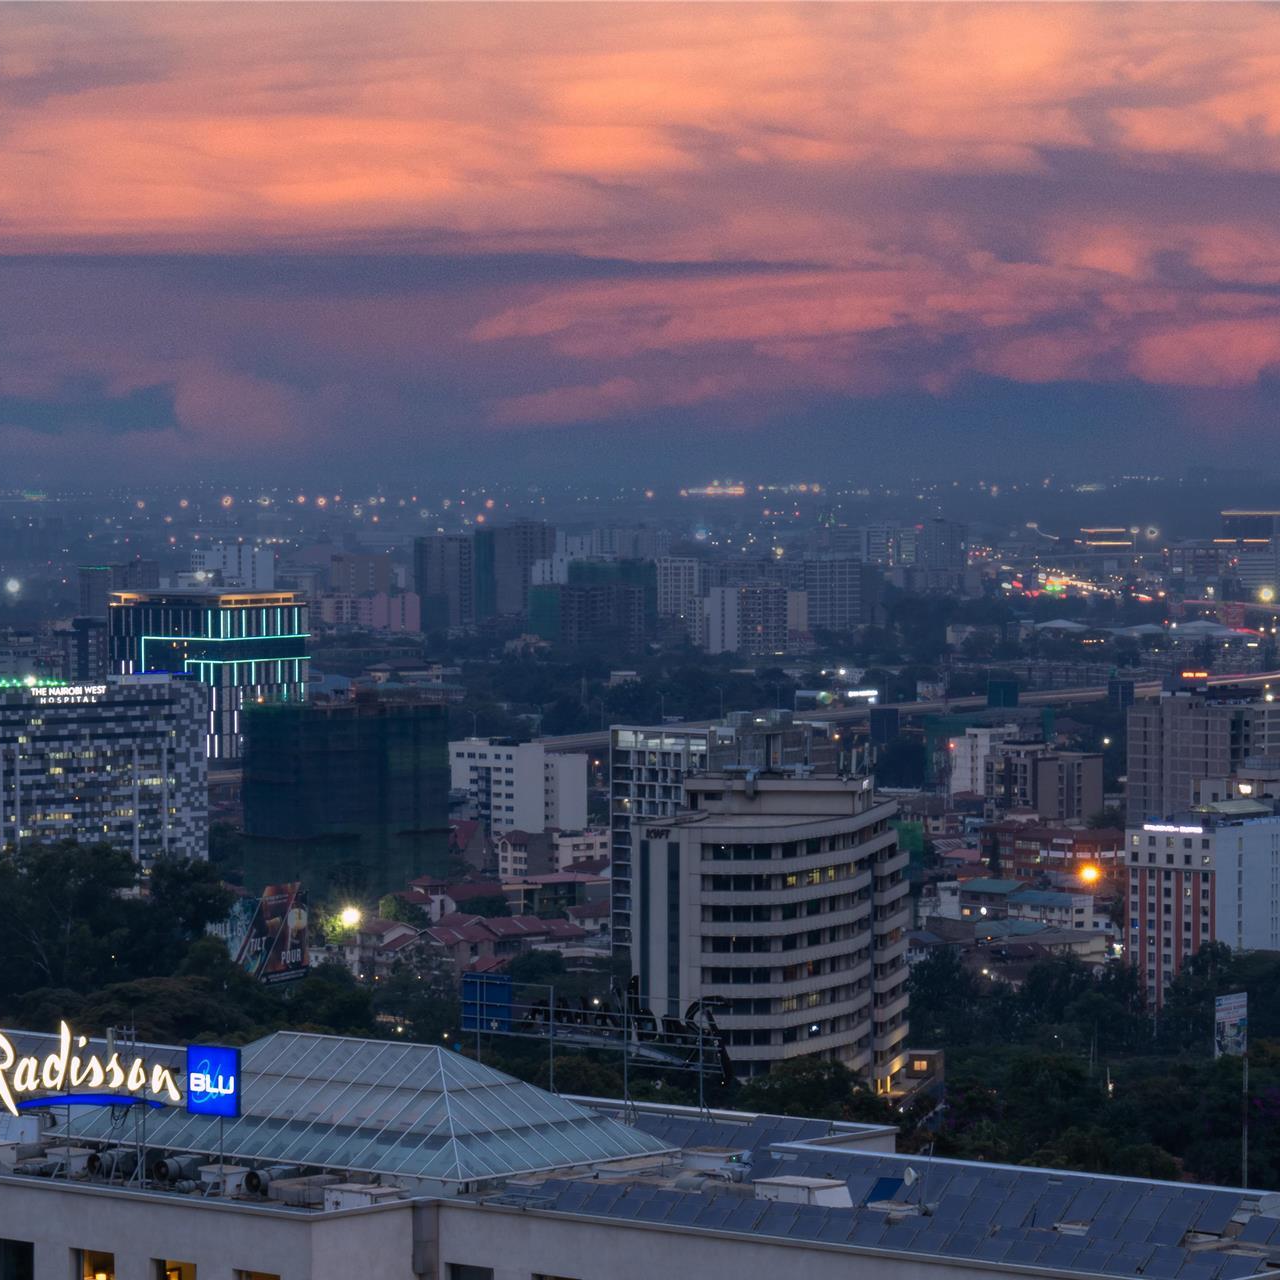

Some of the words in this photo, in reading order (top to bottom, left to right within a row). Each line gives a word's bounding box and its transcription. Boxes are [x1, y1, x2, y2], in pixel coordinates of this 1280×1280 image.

[31, 687, 48, 696] THE
[49, 687, 83, 696] NAIROBI
[84, 685, 106, 695] WEST
[40, 695, 97, 704] HOSPITAL
[190, 1073, 235, 1095] BLU
